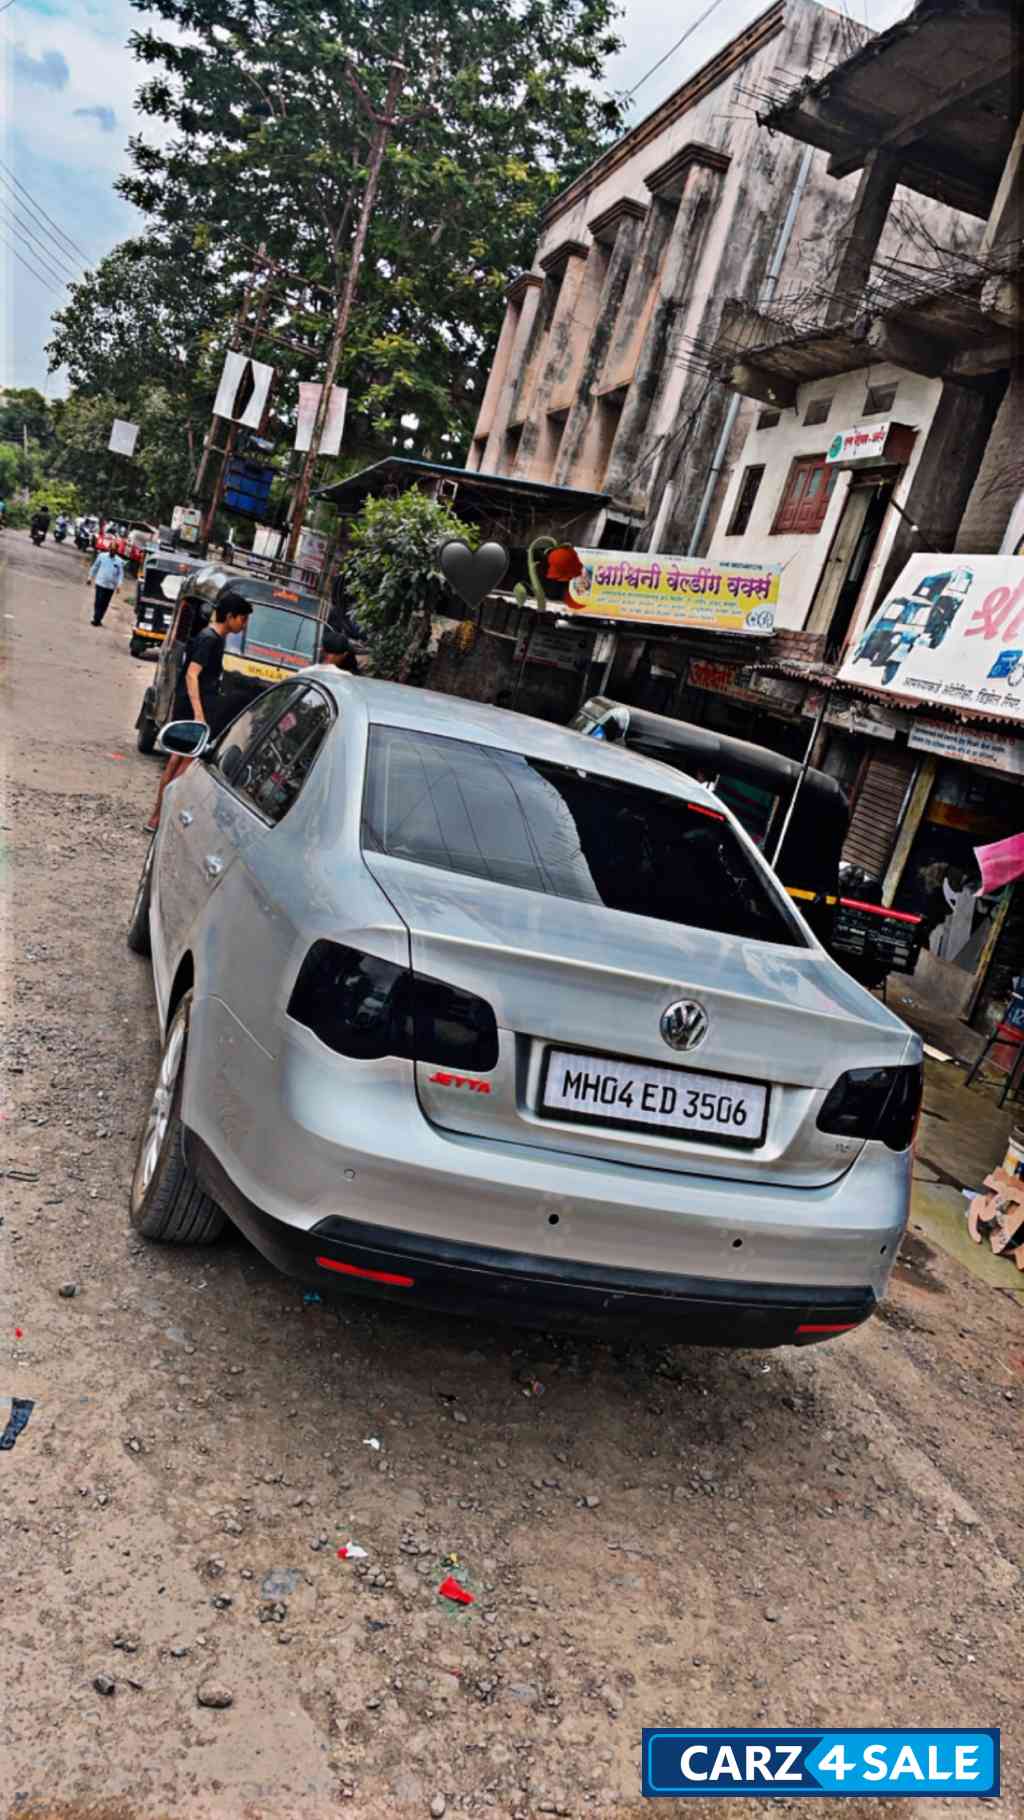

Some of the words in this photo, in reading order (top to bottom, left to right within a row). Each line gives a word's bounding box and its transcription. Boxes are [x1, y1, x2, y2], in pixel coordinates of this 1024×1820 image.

[428, 1071, 492, 1095] JETTA
[562, 1069, 634, 1109] MH04
[641, 1082, 677, 1114] ED
[683, 1090, 747, 1126] 3506
